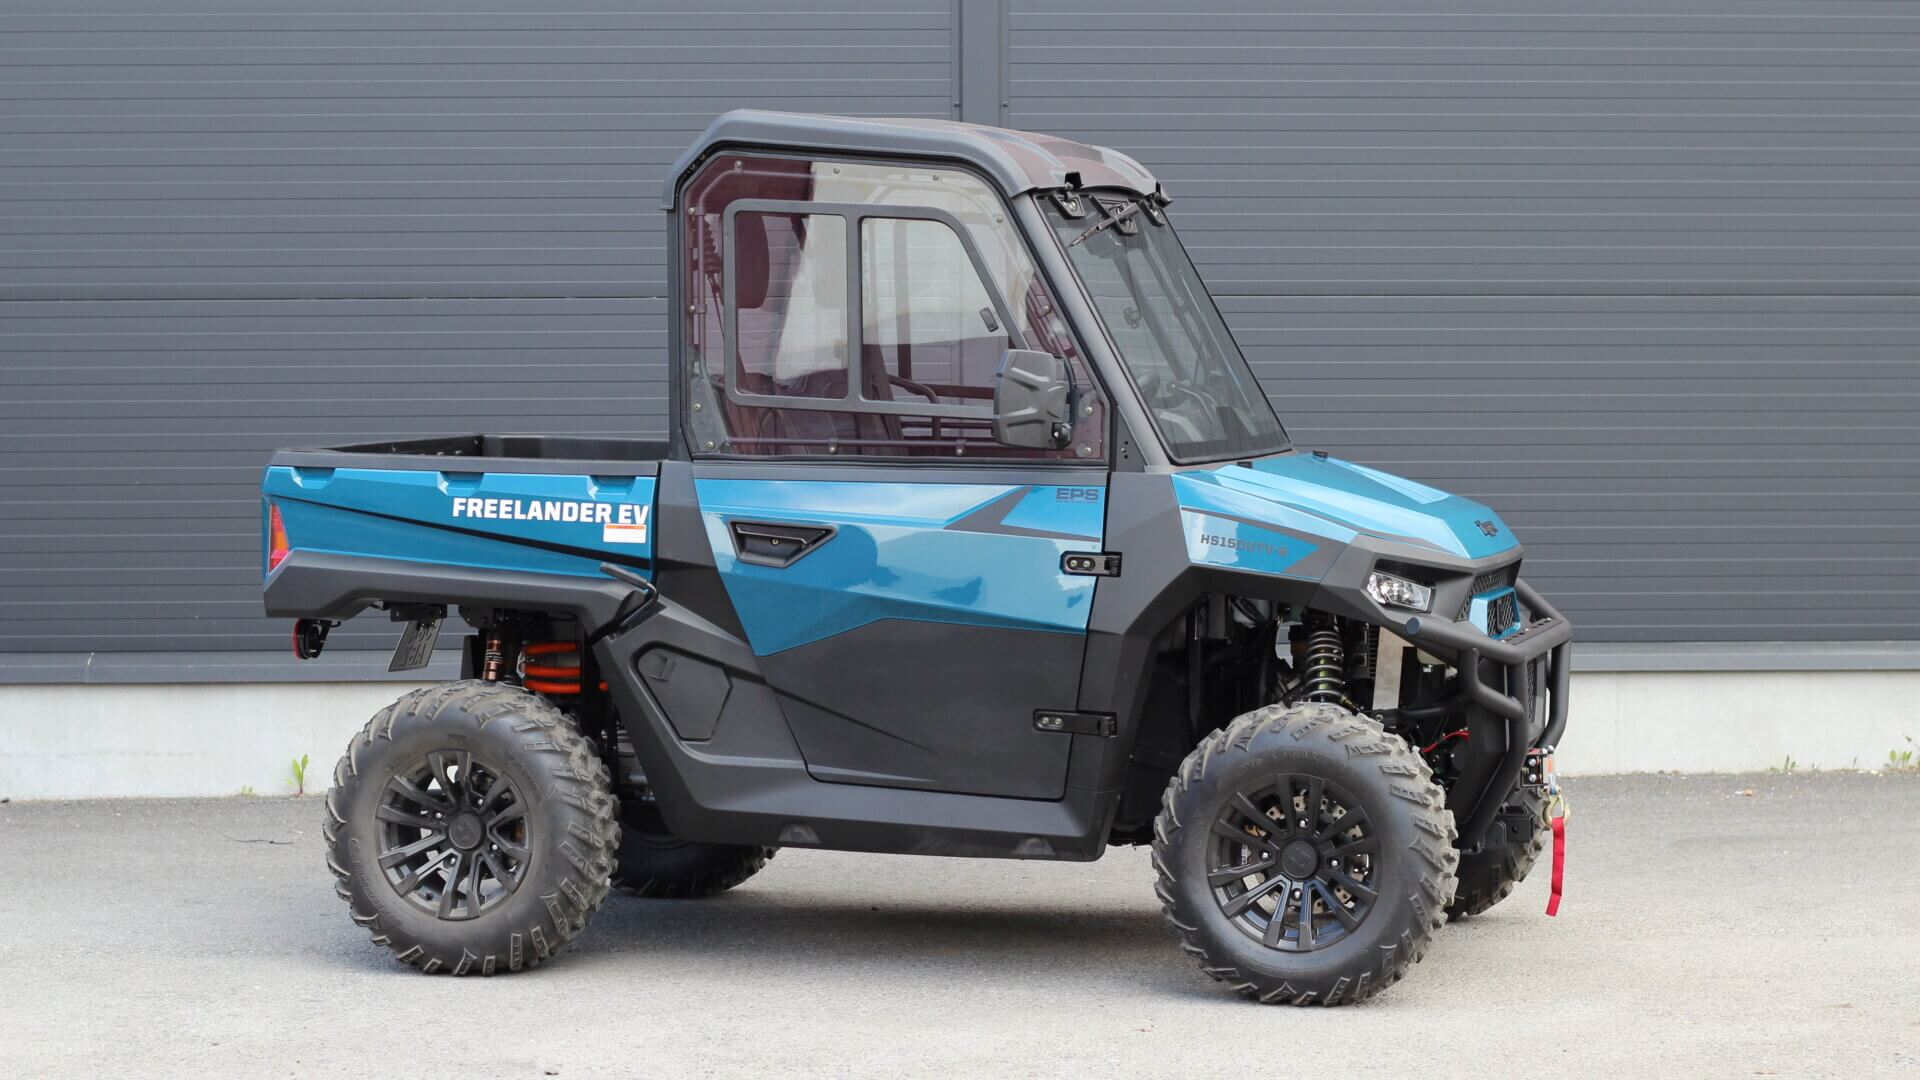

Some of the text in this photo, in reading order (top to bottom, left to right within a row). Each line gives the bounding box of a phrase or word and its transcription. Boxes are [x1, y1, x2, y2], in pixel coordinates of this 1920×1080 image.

[1056, 487, 1099, 500] EPS
[452, 497, 649, 525] FREELANDER EV
